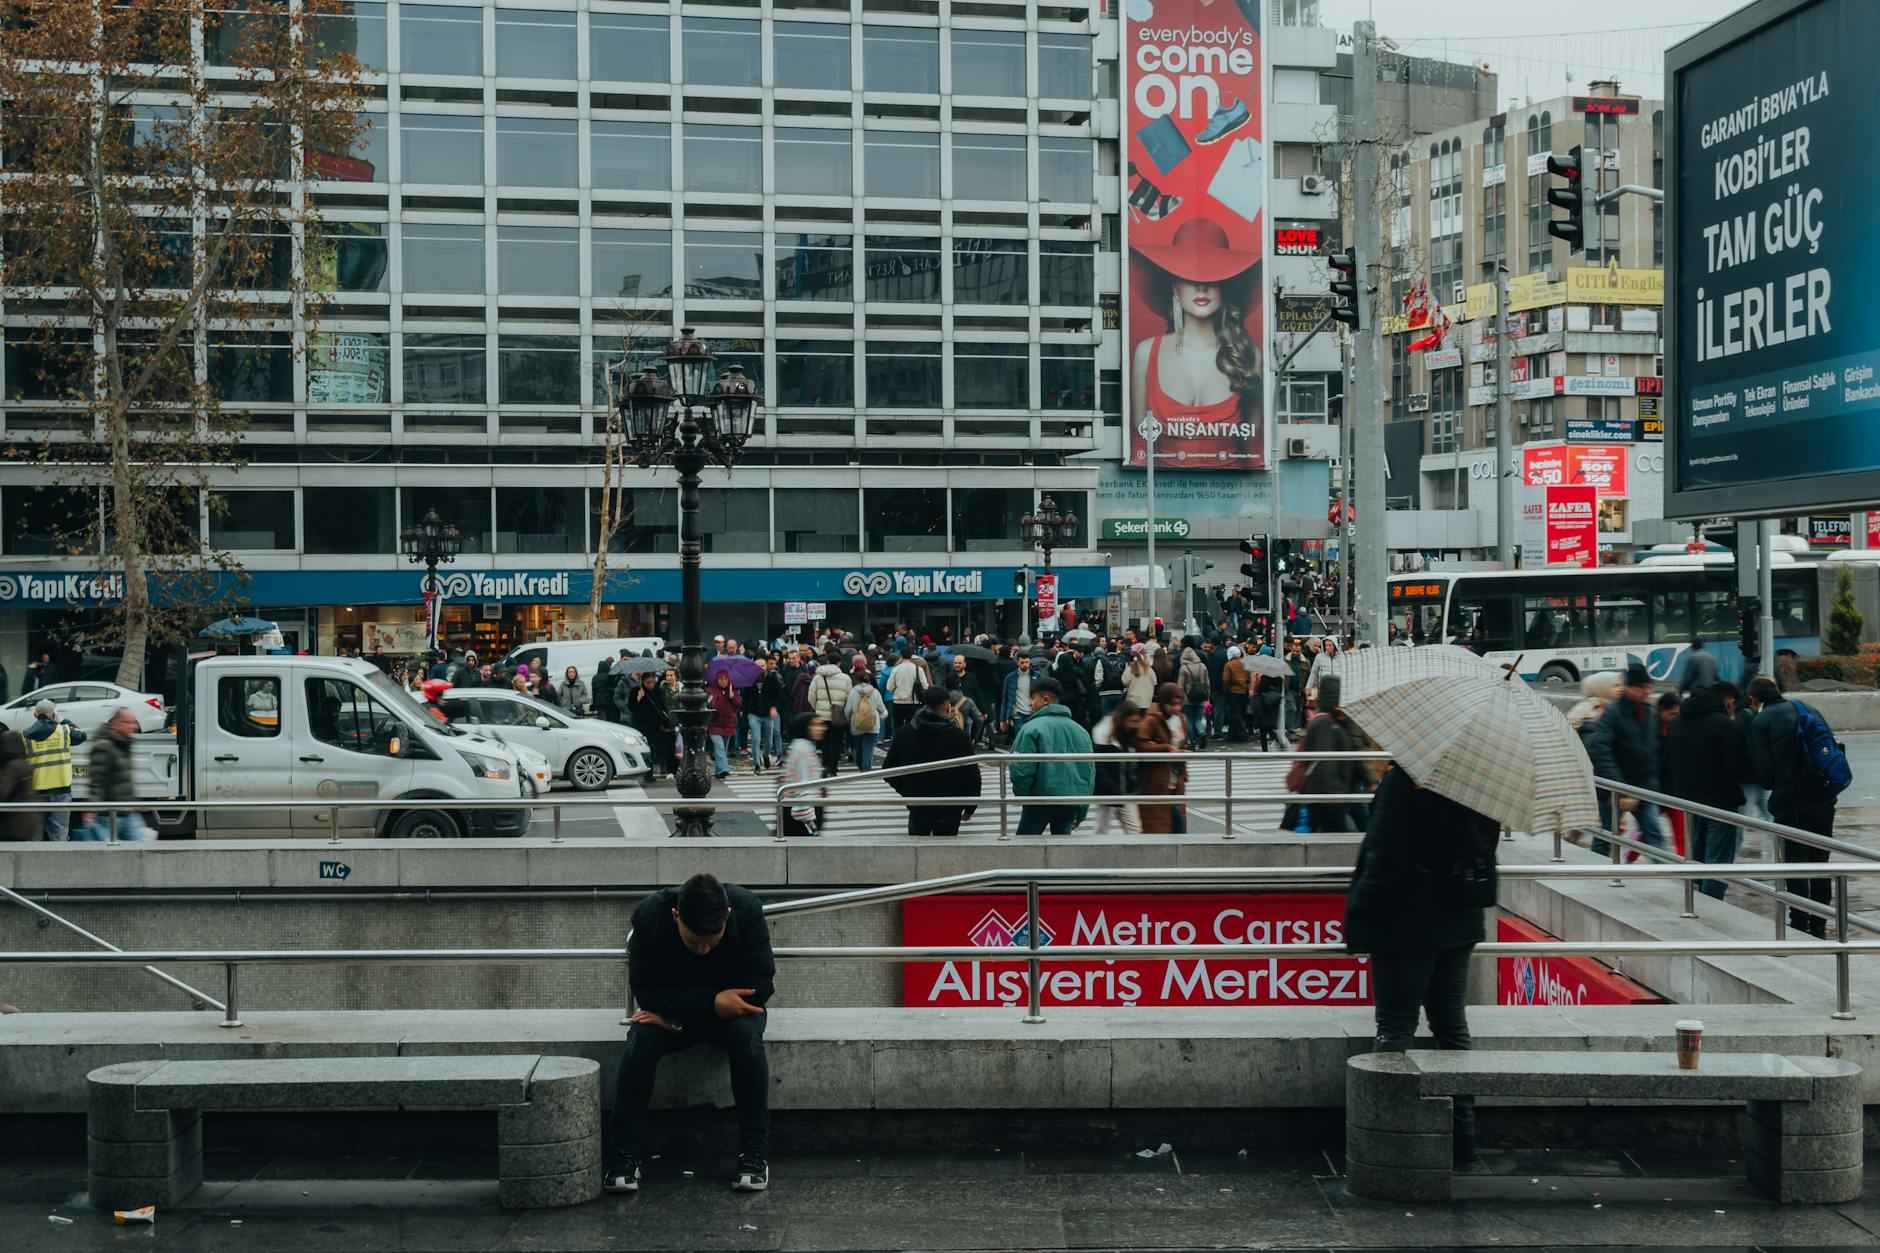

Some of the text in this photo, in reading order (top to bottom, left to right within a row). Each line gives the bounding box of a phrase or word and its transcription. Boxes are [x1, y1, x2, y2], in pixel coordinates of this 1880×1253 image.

[1138, 24, 1253, 48] everybody's
[1136, 44, 1253, 75] come
[1135, 73, 1221, 119] on
[1701, 70, 1829, 149] GARANTİ BBVA'YLA
[1715, 126, 1810, 200] KOBİ'LER
[1278, 229, 1317, 242] LOVE
[1703, 183, 1824, 273] TAM GÜÇ
[1575, 275, 1606, 289] CITI
[1620, 275, 1664, 292] Englis
[1280, 311, 1326, 320] EPİLASYO
[1697, 267, 1832, 362] İLERLER
[1569, 377, 1631, 391] gezinomi
[1783, 375, 1812, 394] Finansal
[1844, 365, 1872, 384] Girişim
[1744, 385, 1777, 402] Tek Ekran
[1549, 502, 1592, 513] ZAFER
[322, 863, 345, 877] WC
[1071, 910, 1196, 946] Metro
[1160, 957, 1368, 1000] Merkezi
